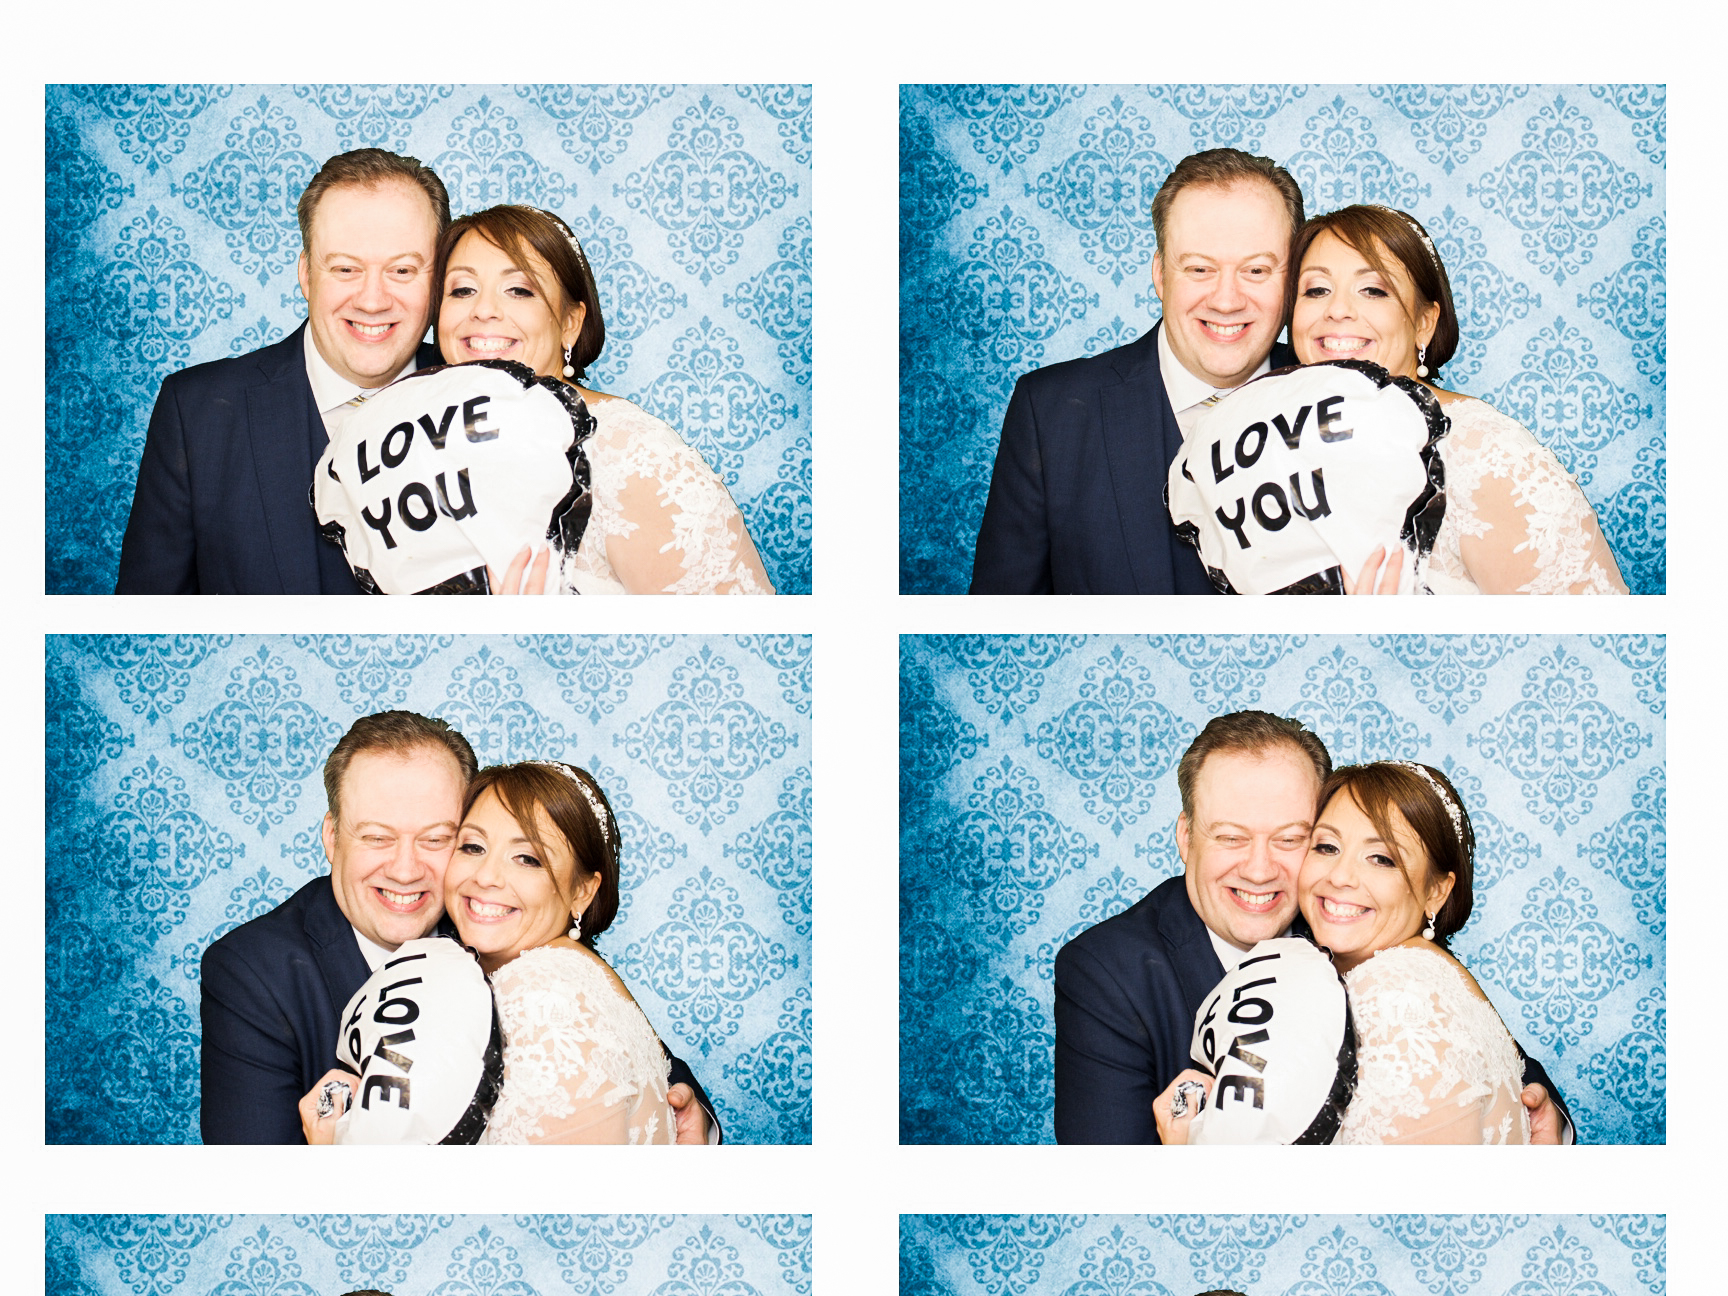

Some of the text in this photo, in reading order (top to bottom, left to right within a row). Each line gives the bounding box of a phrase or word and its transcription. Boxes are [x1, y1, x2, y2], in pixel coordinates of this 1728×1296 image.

[357, 395, 500, 484] LOVE
[1211, 395, 1354, 484] LOVE
[361, 467, 478, 550] YOU
[1215, 467, 1332, 550] YOU
[361, 953, 427, 1111] I LOVE
[1215, 953, 1281, 1111] I LOVE
